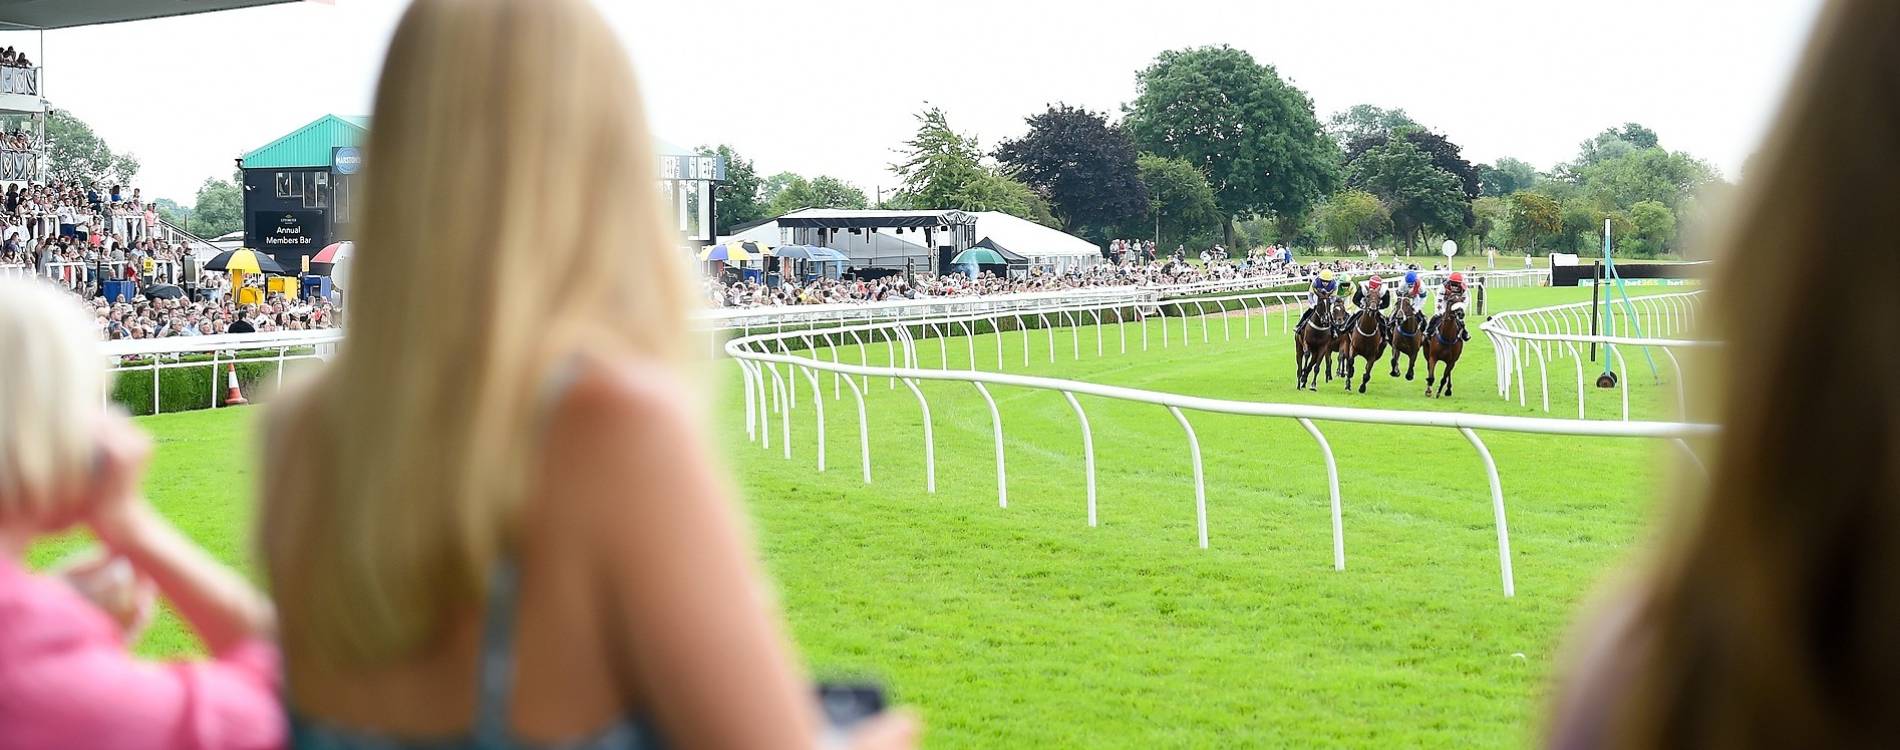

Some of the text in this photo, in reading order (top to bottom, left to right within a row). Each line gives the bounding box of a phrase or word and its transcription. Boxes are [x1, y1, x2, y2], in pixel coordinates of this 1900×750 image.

[277, 226, 301, 234] Annual
[266, 236, 312, 244] Members Bar
